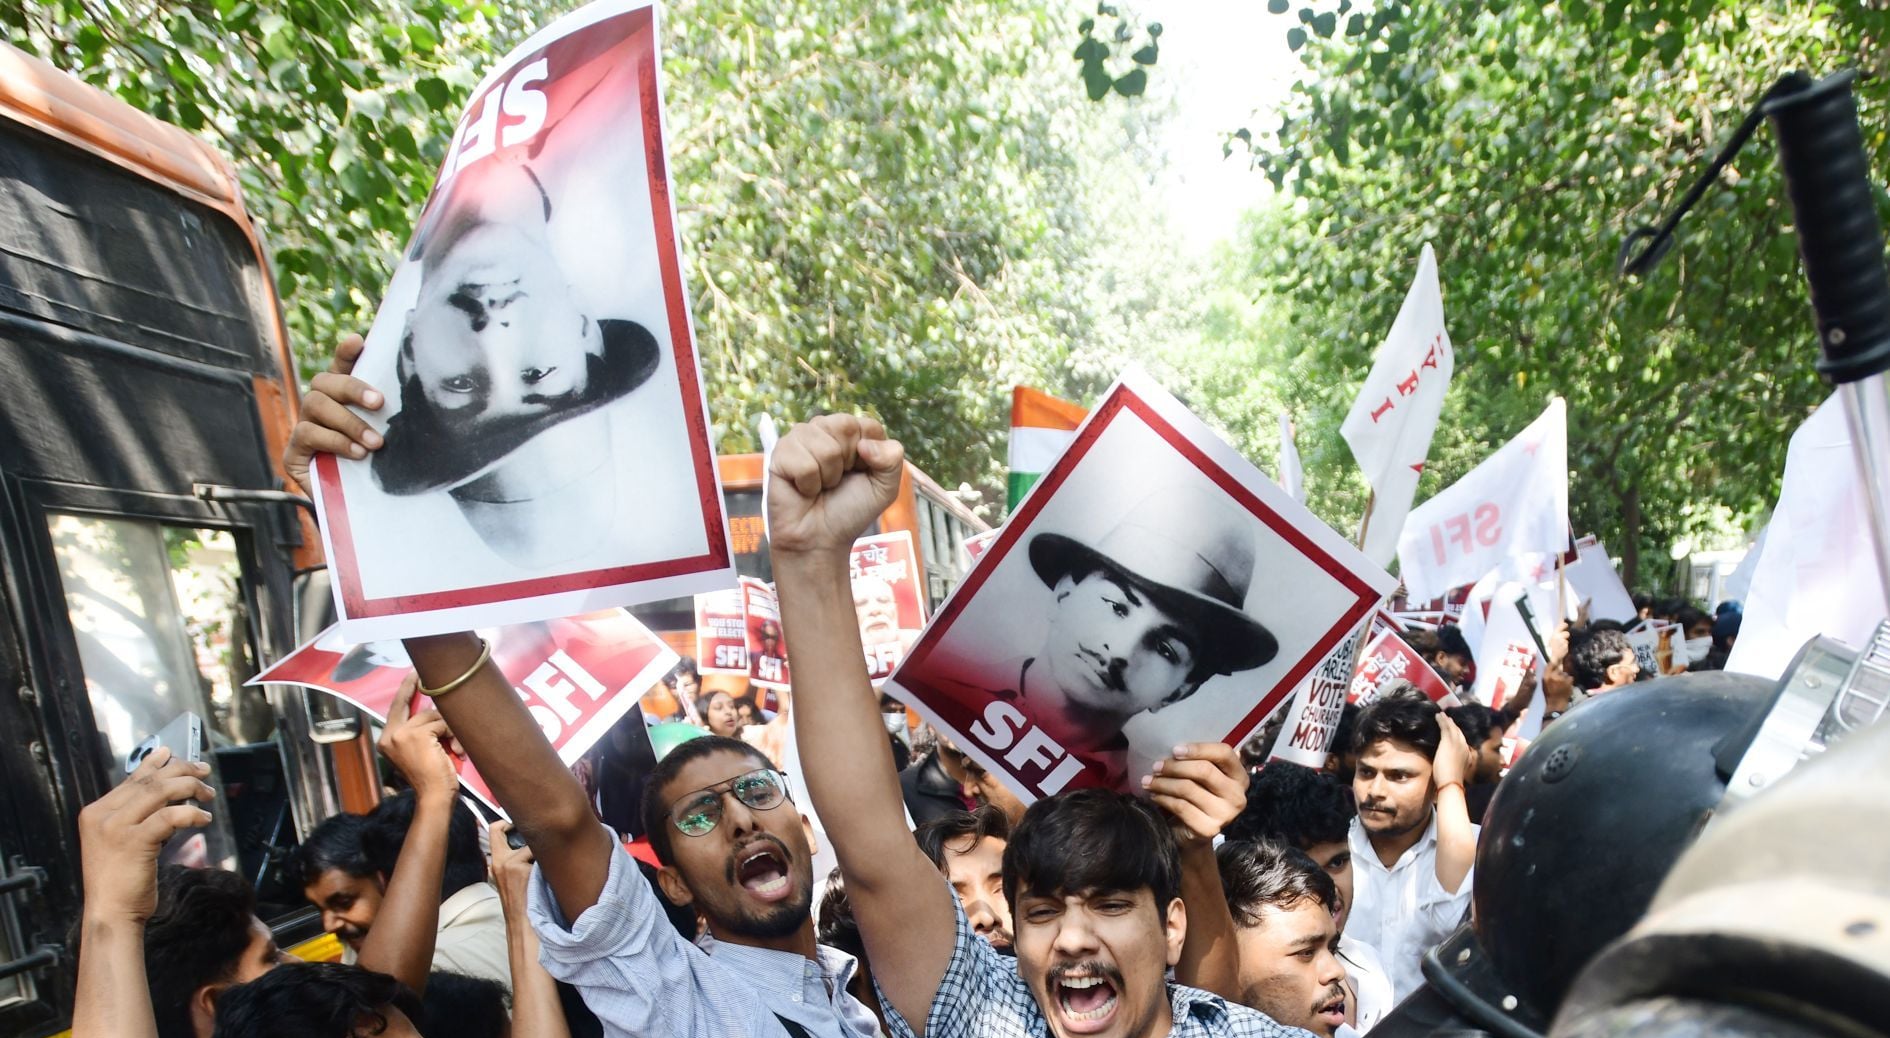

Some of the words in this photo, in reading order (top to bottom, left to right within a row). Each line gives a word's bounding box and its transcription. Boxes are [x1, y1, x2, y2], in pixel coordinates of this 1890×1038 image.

[436, 57, 548, 190] SFI
[715, 644, 746, 669] SFI
[758, 655, 782, 681] SFI
[1308, 677, 1346, 709] VOTE
[969, 700, 1086, 797] SFI
